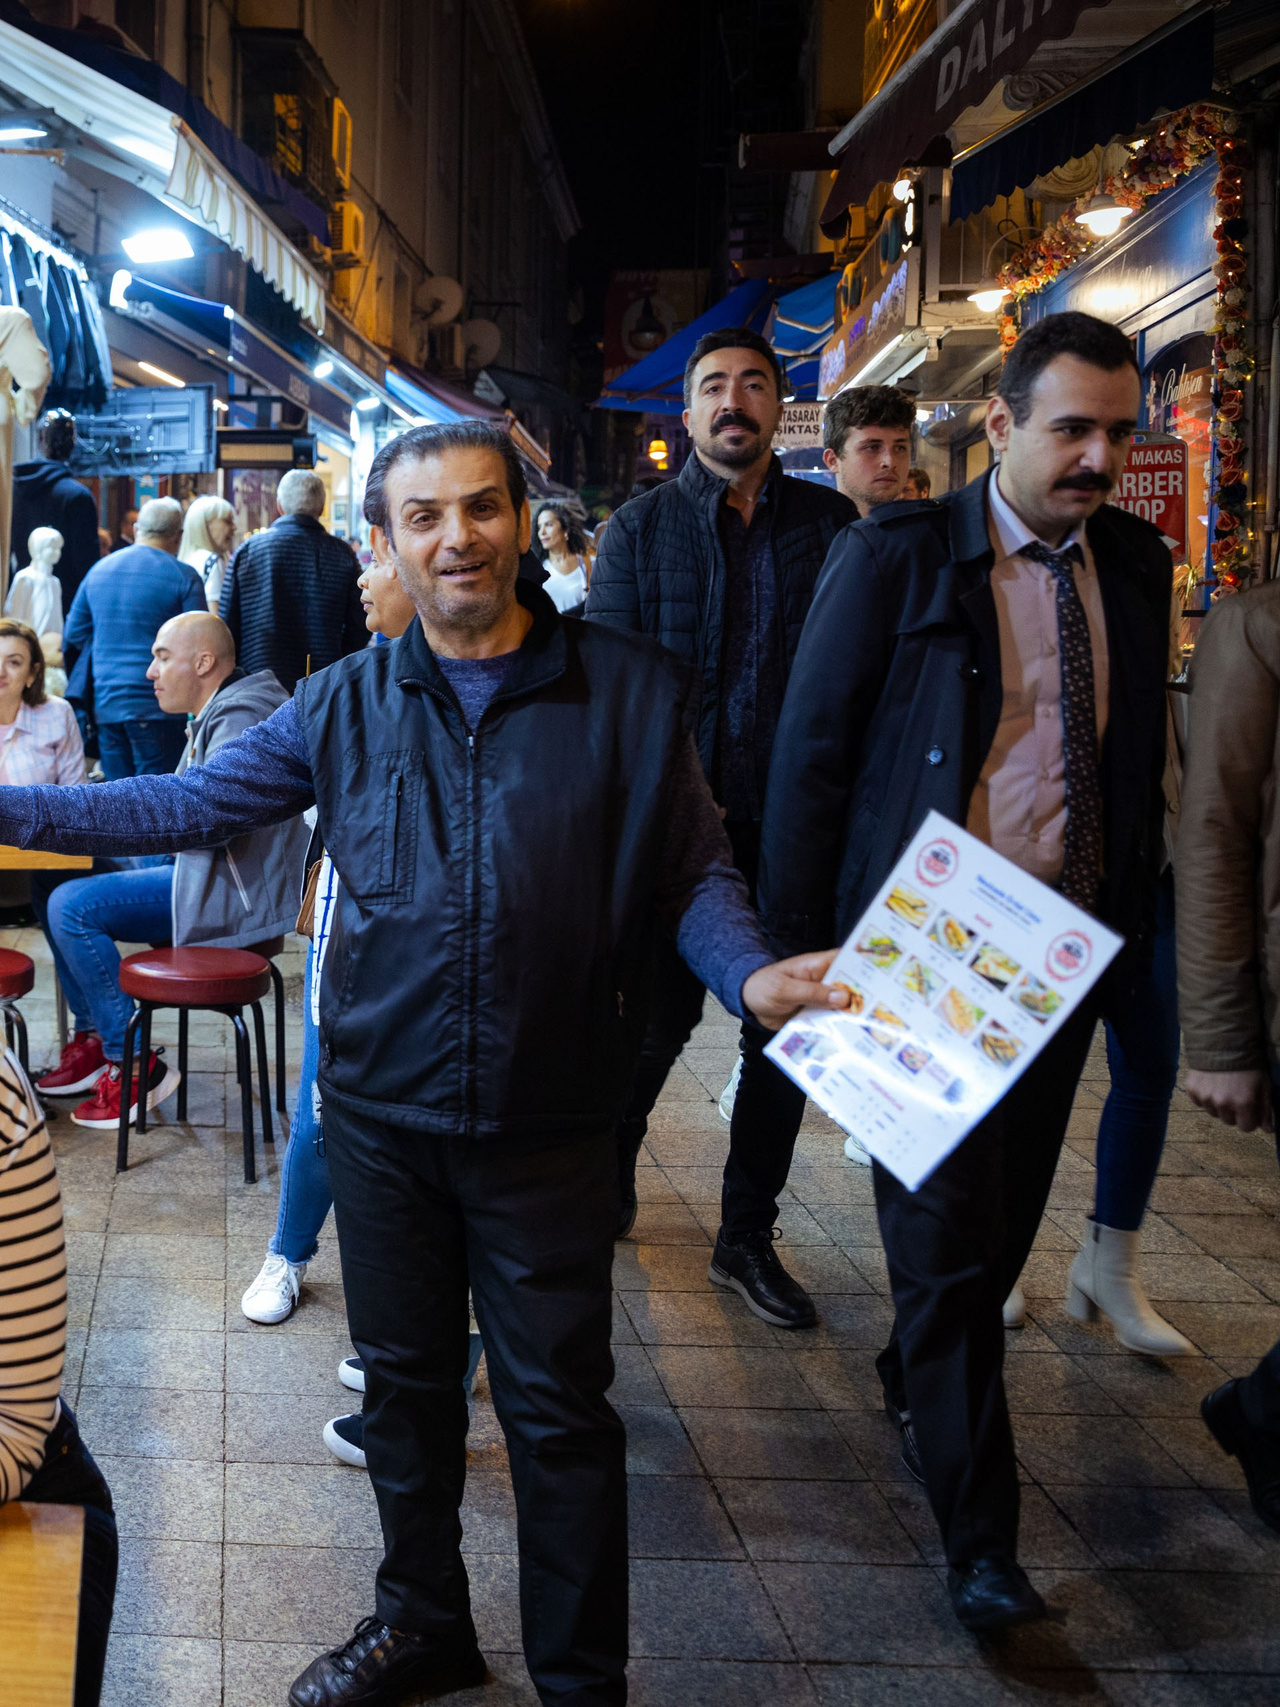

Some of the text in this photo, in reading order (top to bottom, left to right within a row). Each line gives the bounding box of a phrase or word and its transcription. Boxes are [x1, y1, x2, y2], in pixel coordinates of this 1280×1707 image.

[782, 409, 820, 422] TASARAY
[776, 423, 820, 436] ŞİKTAŞ
[1131, 449, 1183, 465] MAKAS
[1111, 499, 1166, 524] HOP
